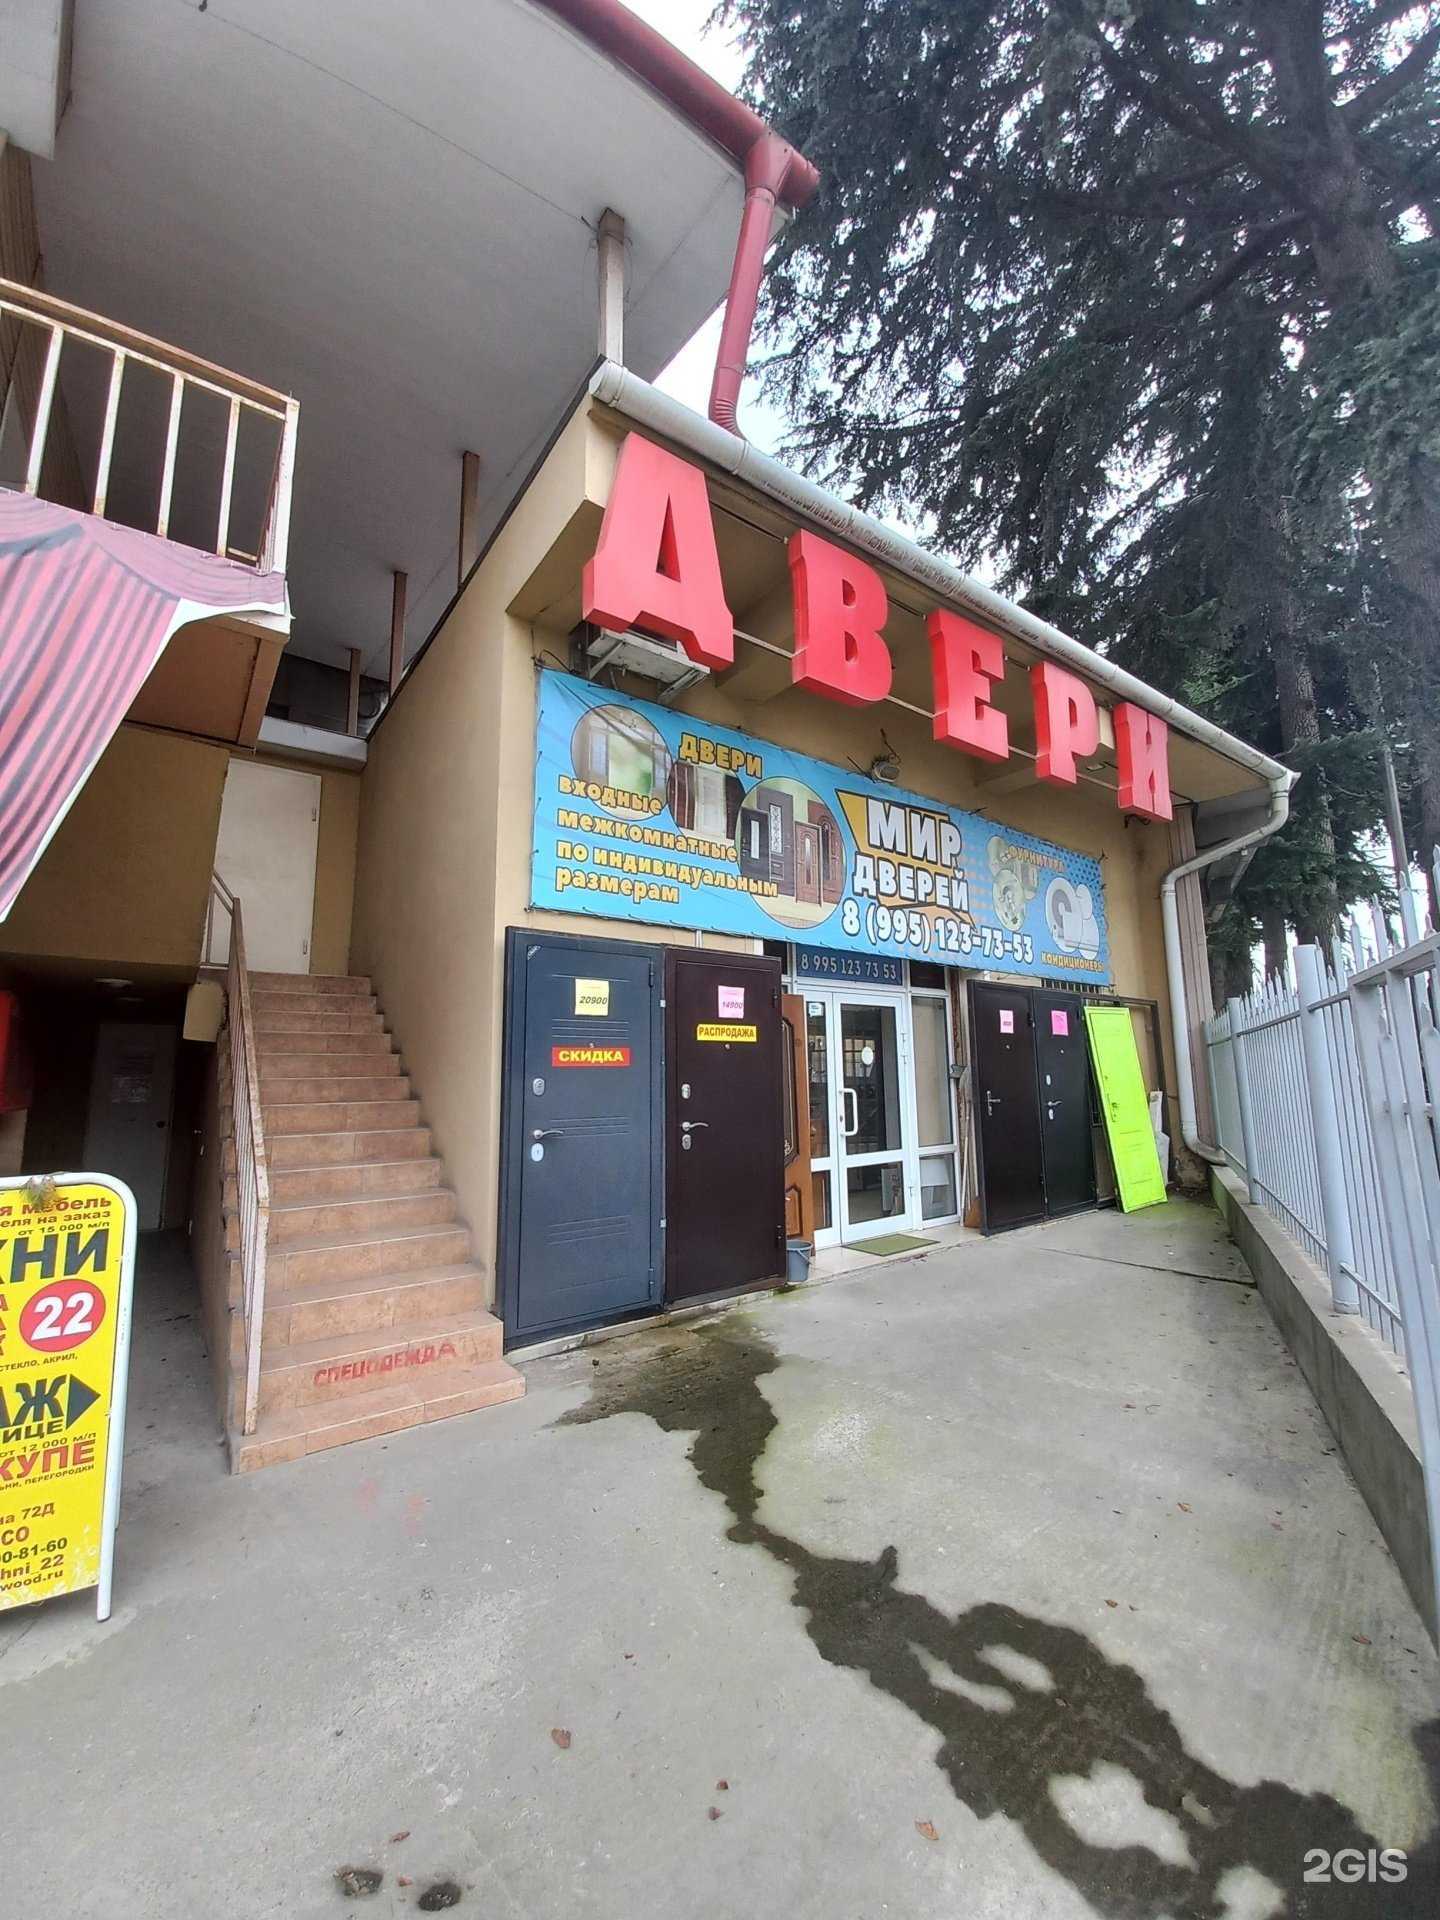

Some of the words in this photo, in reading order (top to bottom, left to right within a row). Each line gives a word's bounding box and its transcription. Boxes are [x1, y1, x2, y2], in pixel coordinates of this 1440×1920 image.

[583, 431, 1173, 822] ДВЕРИ
[679, 732, 763, 779] ДВЕРИ
[558, 775, 662, 815] входные
[557, 808, 737, 862] межкомнатные
[866, 797, 962, 868] МИР
[555, 867, 679, 903] размерам
[556, 840, 589, 861] по
[592, 847, 778, 898] индивидуальным
[853, 852, 969, 913] ДВЕРЕЙ
[842, 899, 860, 936] 8
[866, 903, 931, 953] (995)
[934, 916, 1034, 964] 123-73-53
[801, 954, 809, 970] 8
[813, 955, 837, 973] 995
[841, 958, 861, 975] 123
[866, 961, 879, 978] 73
[883, 964, 896, 980] 53
[579, 995, 608, 1006] 20900
[698, 1026, 755, 1038] РАСПРОДАЖА
[559, 1050, 624, 1063] СКИДКА
[38, 1216, 57, 1225] на
[64, 1211, 110, 1222] заказ
[60, 1223, 83, 1231] 000
[31, 1292, 94, 1340] 22
[23, 1444, 37, 1452] 12
[43, 1437, 67, 1449] 000
[25, 1465, 94, 1484] ПЕРЕГОРОДКИ
[21, 1502, 54, 1519] 72Д
